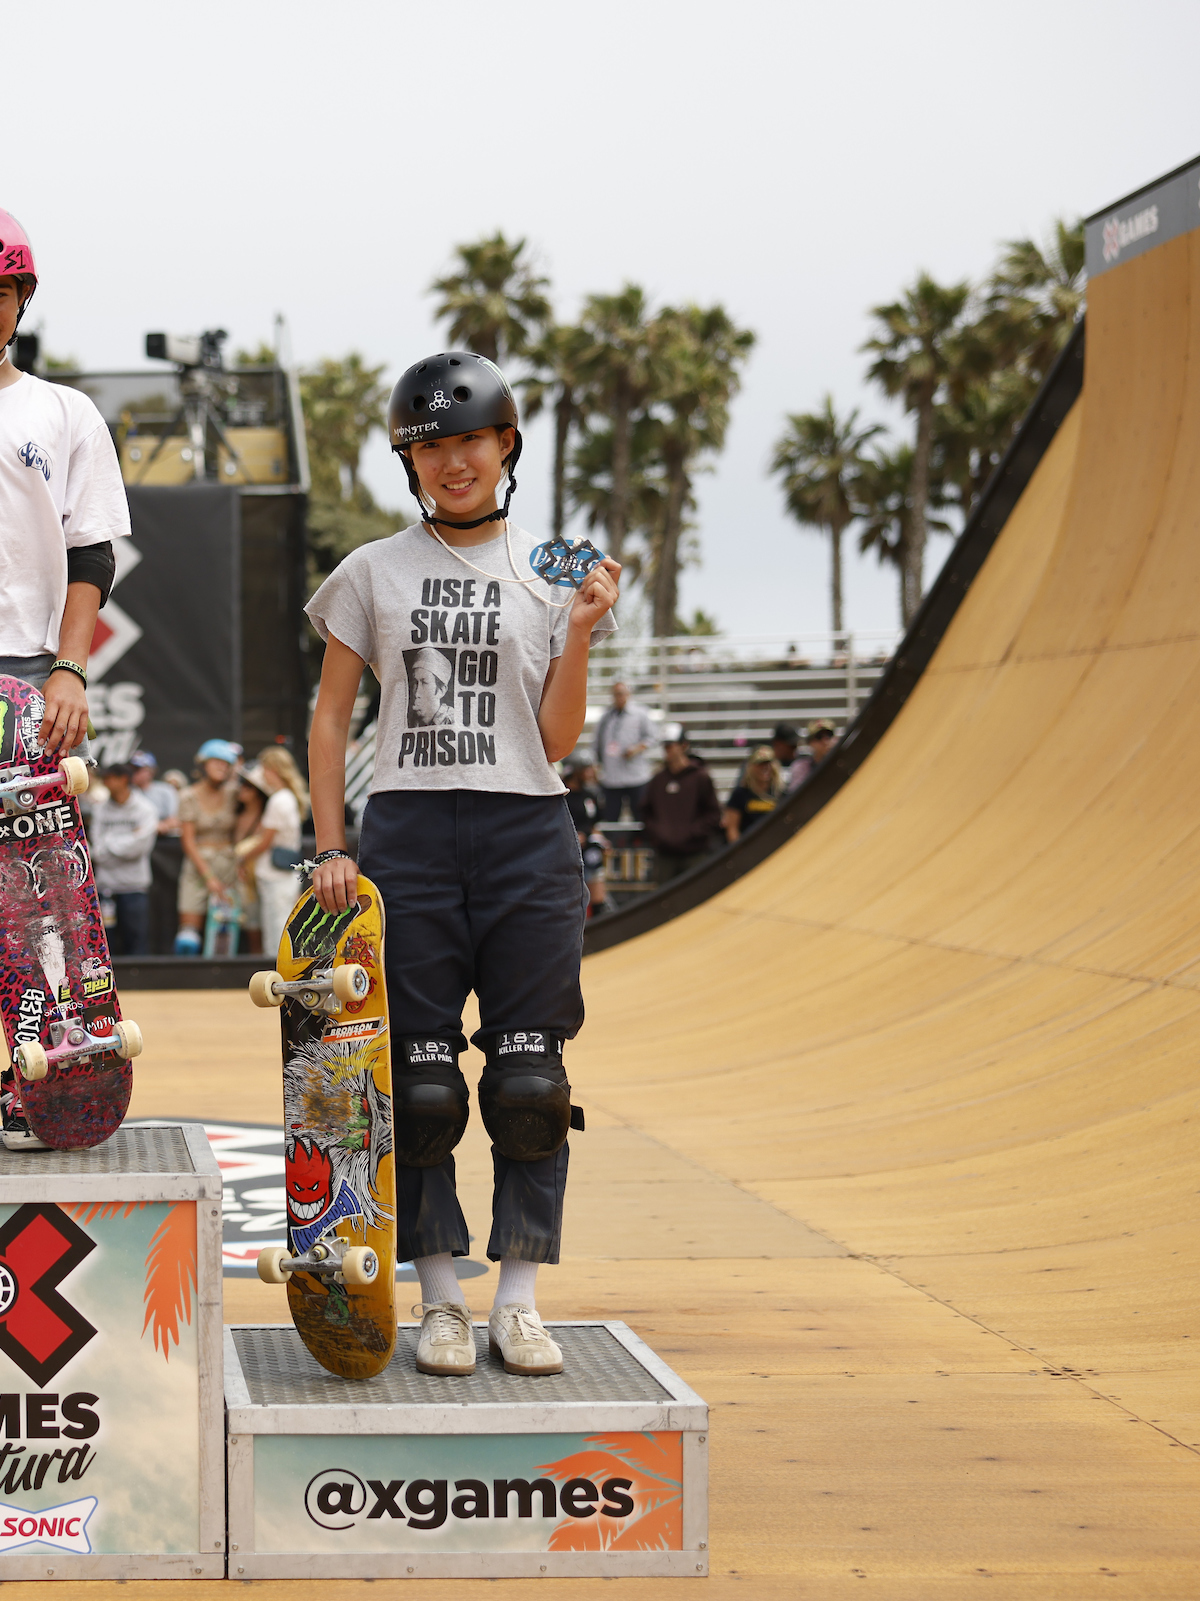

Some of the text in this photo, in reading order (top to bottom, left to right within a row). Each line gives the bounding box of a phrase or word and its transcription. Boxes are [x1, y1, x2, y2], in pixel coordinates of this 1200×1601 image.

[3, 250, 26, 272] S1
[393, 421, 440, 437] MONSTER
[404, 434, 424, 442] ARMY
[421, 578, 501, 608] USE A
[410, 608, 501, 646] SKATE
[458, 650, 498, 687] GO
[457, 690, 496, 728] TO
[398, 729, 497, 769] PRISON
[43, 1001, 84, 1018] SKTBRDS
[330, 1023, 373, 1036] BRONSON
[501, 1032, 543, 1046] 187
[412, 1042, 449, 1054] 187
[499, 1044, 523, 1055] KILLER
[524, 1044, 545, 1053] PADS
[409, 1053, 436, 1063] KILLER
[304, 1468, 635, 1530] @xgames
[0, 1517, 82, 1538] SONIC
